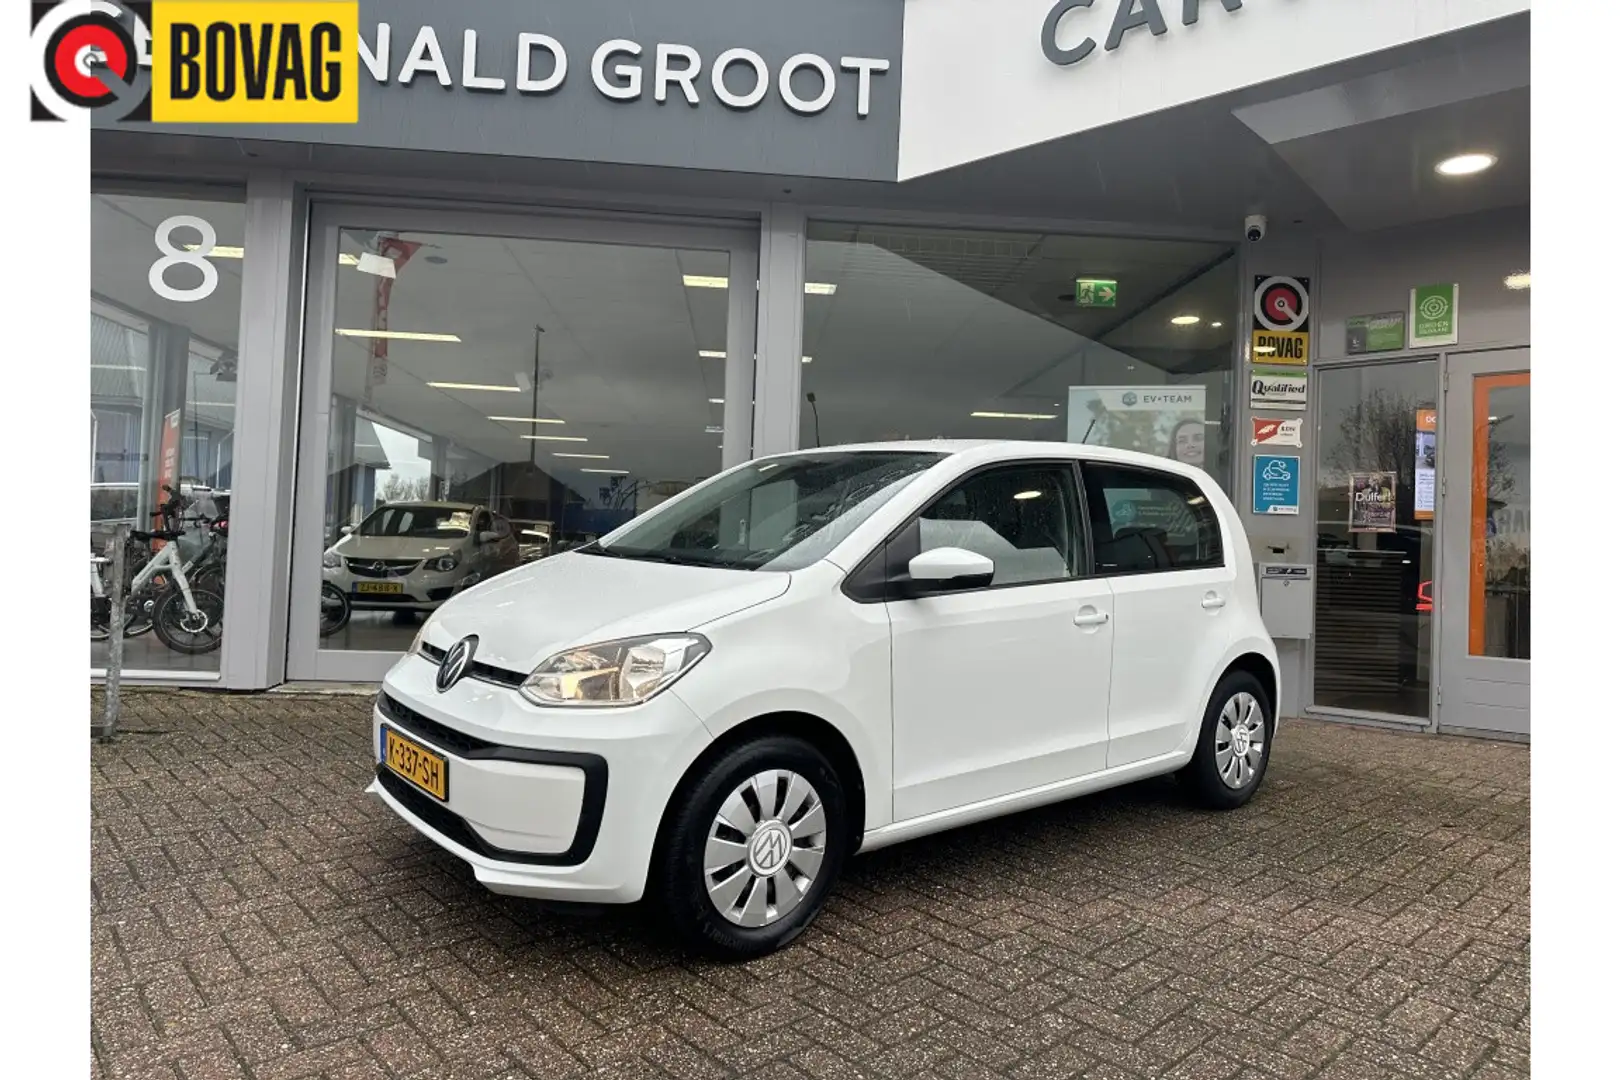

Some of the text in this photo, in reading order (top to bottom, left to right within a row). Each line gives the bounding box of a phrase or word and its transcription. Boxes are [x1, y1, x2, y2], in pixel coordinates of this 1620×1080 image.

[358, 22, 890, 116] NALD GROOT
[148, 215, 219, 302] 8
[1257, 336, 1303, 359] BOVAG
[1252, 380, 1306, 396] Qualified
[389, 736, 439, 792] K-337-SH
